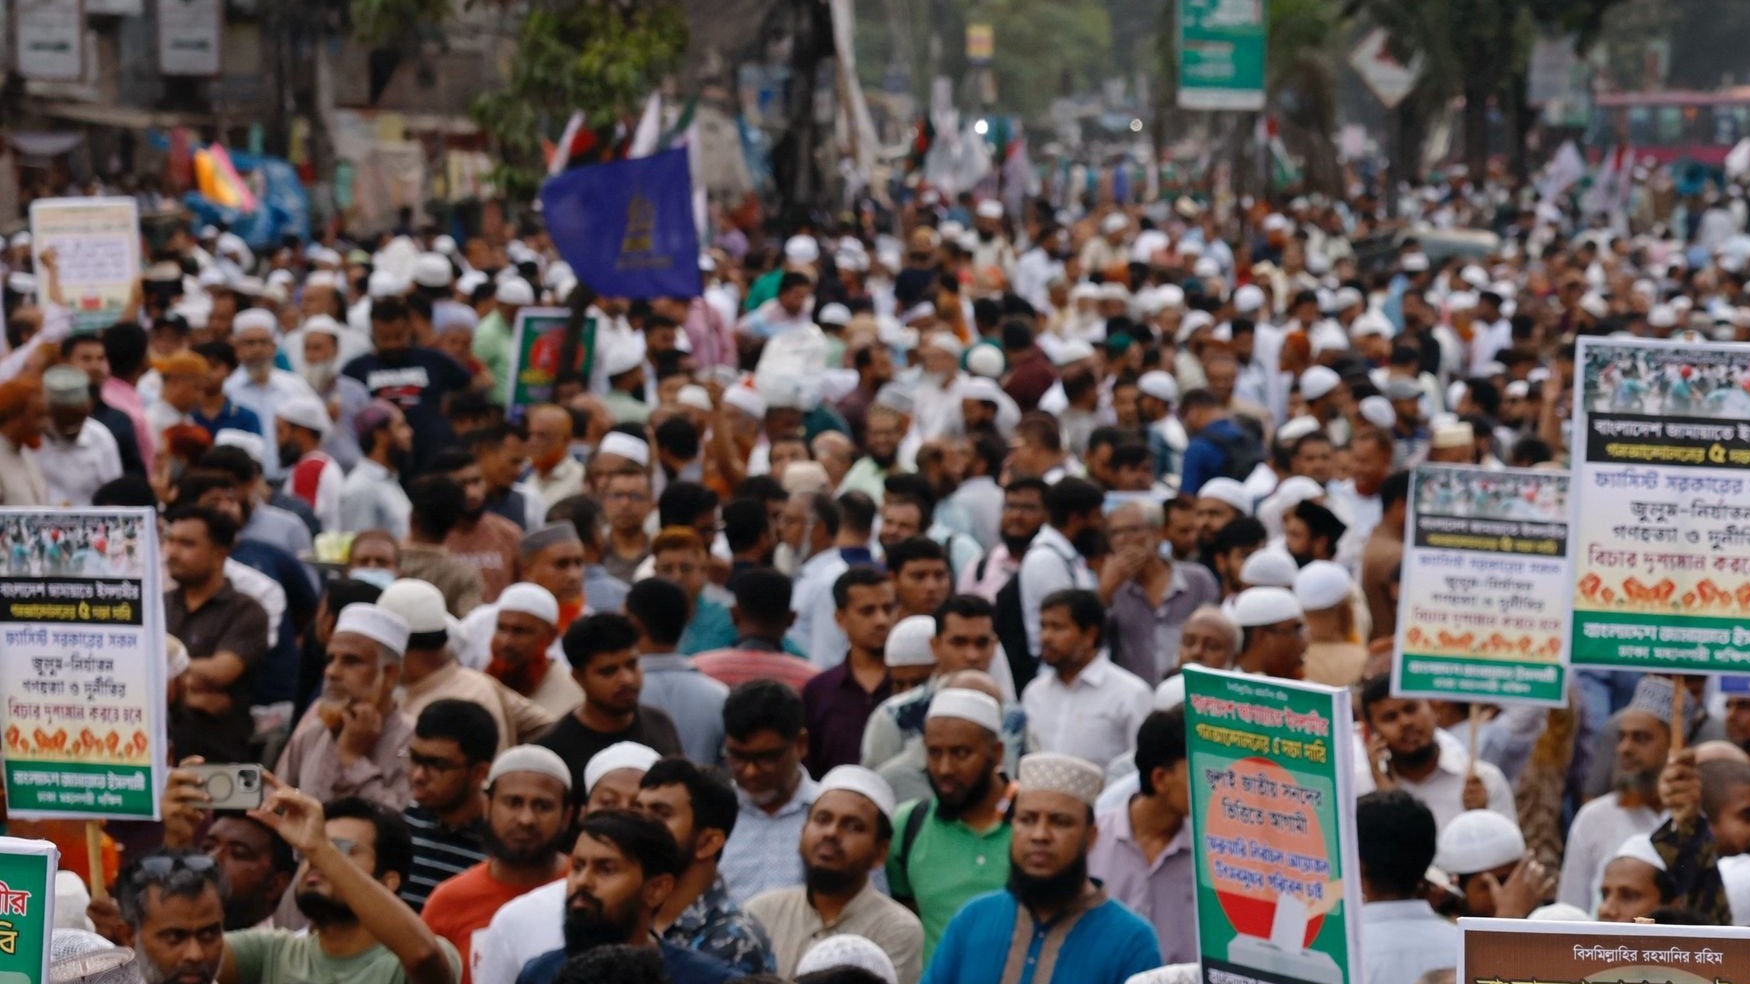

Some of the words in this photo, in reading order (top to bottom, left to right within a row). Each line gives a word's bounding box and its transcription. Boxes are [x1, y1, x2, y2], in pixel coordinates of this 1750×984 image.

[1684, 527, 1701, 545] ও
[1573, 944, 1638, 963] বিসমিল্লাহির
[1642, 948, 1691, 963] রহমানির
[1694, 949, 1723, 964] রহিম
